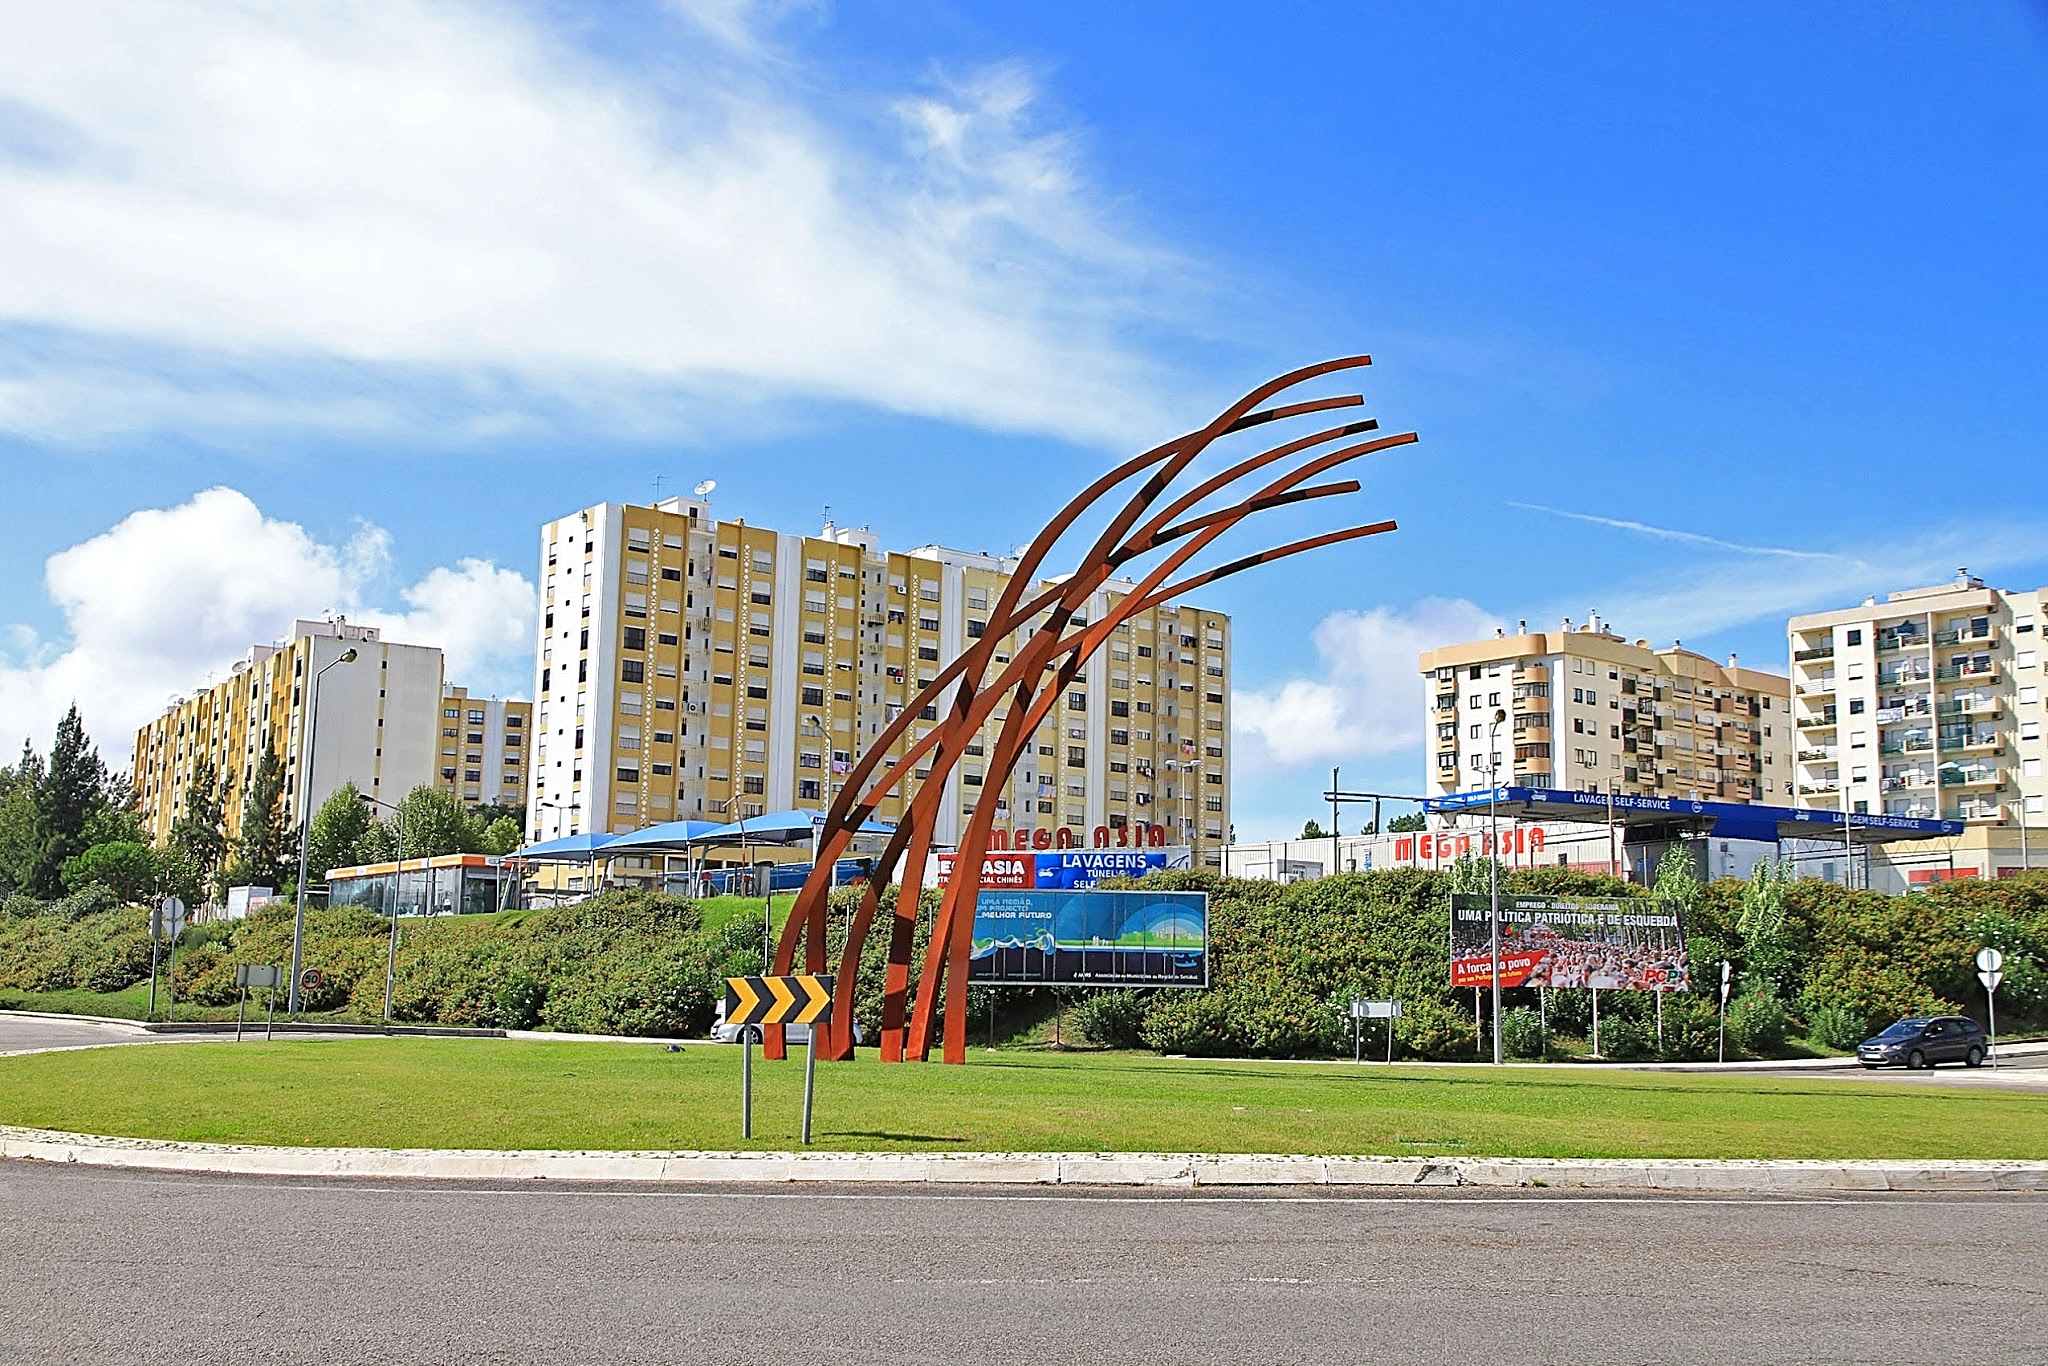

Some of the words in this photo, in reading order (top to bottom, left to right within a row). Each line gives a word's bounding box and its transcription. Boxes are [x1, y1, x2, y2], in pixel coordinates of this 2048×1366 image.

[1615, 796, 1671, 810] SELF-SERVICE
[1870, 816, 1920, 829] SELF-SERVICE
[986, 827, 1073, 850] MEGA
[1094, 825, 1165, 848] ASIA
[1395, 832, 1471, 861] MEGA
[1482, 827, 1545, 856] ASIA
[982, 860, 1025, 875] ASIA
[1062, 854, 1147, 869] LAVAGENS
[996, 875, 1023, 884] CHINÊS
[1515, 901, 1546, 909] EMPREGO
[1551, 902, 1580, 910] DIREITOS
[1584, 902, 1620, 911] SOBERANIA
[1018, 911, 1053, 919] FUTURO
[1457, 909, 1482, 921] UMA
[1484, 908, 1532, 923] PLÍTICA
[1534, 910, 1595, 925] PATRIÓTICA
[1597, 914, 1605, 925] E
[1606, 914, 1621, 926] DE
[1457, 963, 1466, 975] A
[1466, 962, 1492, 974] força
[1507, 957, 1531, 971] povo
[304, 974, 319, 984] 50
[1644, 969, 1679, 983] PCP
